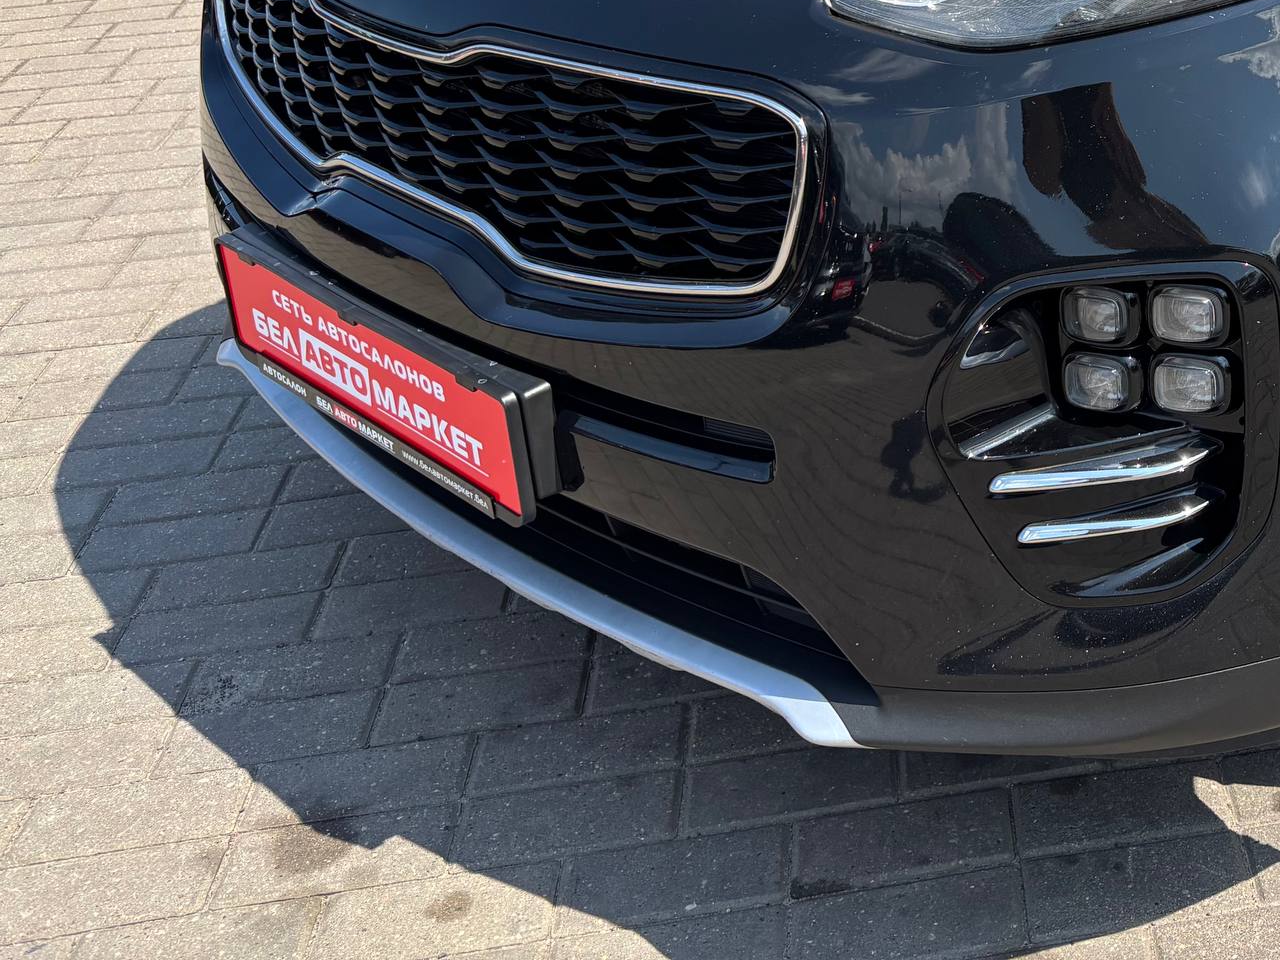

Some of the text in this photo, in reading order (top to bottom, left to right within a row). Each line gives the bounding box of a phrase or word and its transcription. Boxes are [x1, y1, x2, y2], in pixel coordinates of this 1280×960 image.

[252, 307, 484, 467] БЕЛ АВТО МАРКЕТ
[271, 289, 446, 402] СЕТЬ АВТОСАЛОНОВ
[263, 363, 307, 397] АВТОСАЛОН
[359, 421, 394, 449] МАРКЕТ
